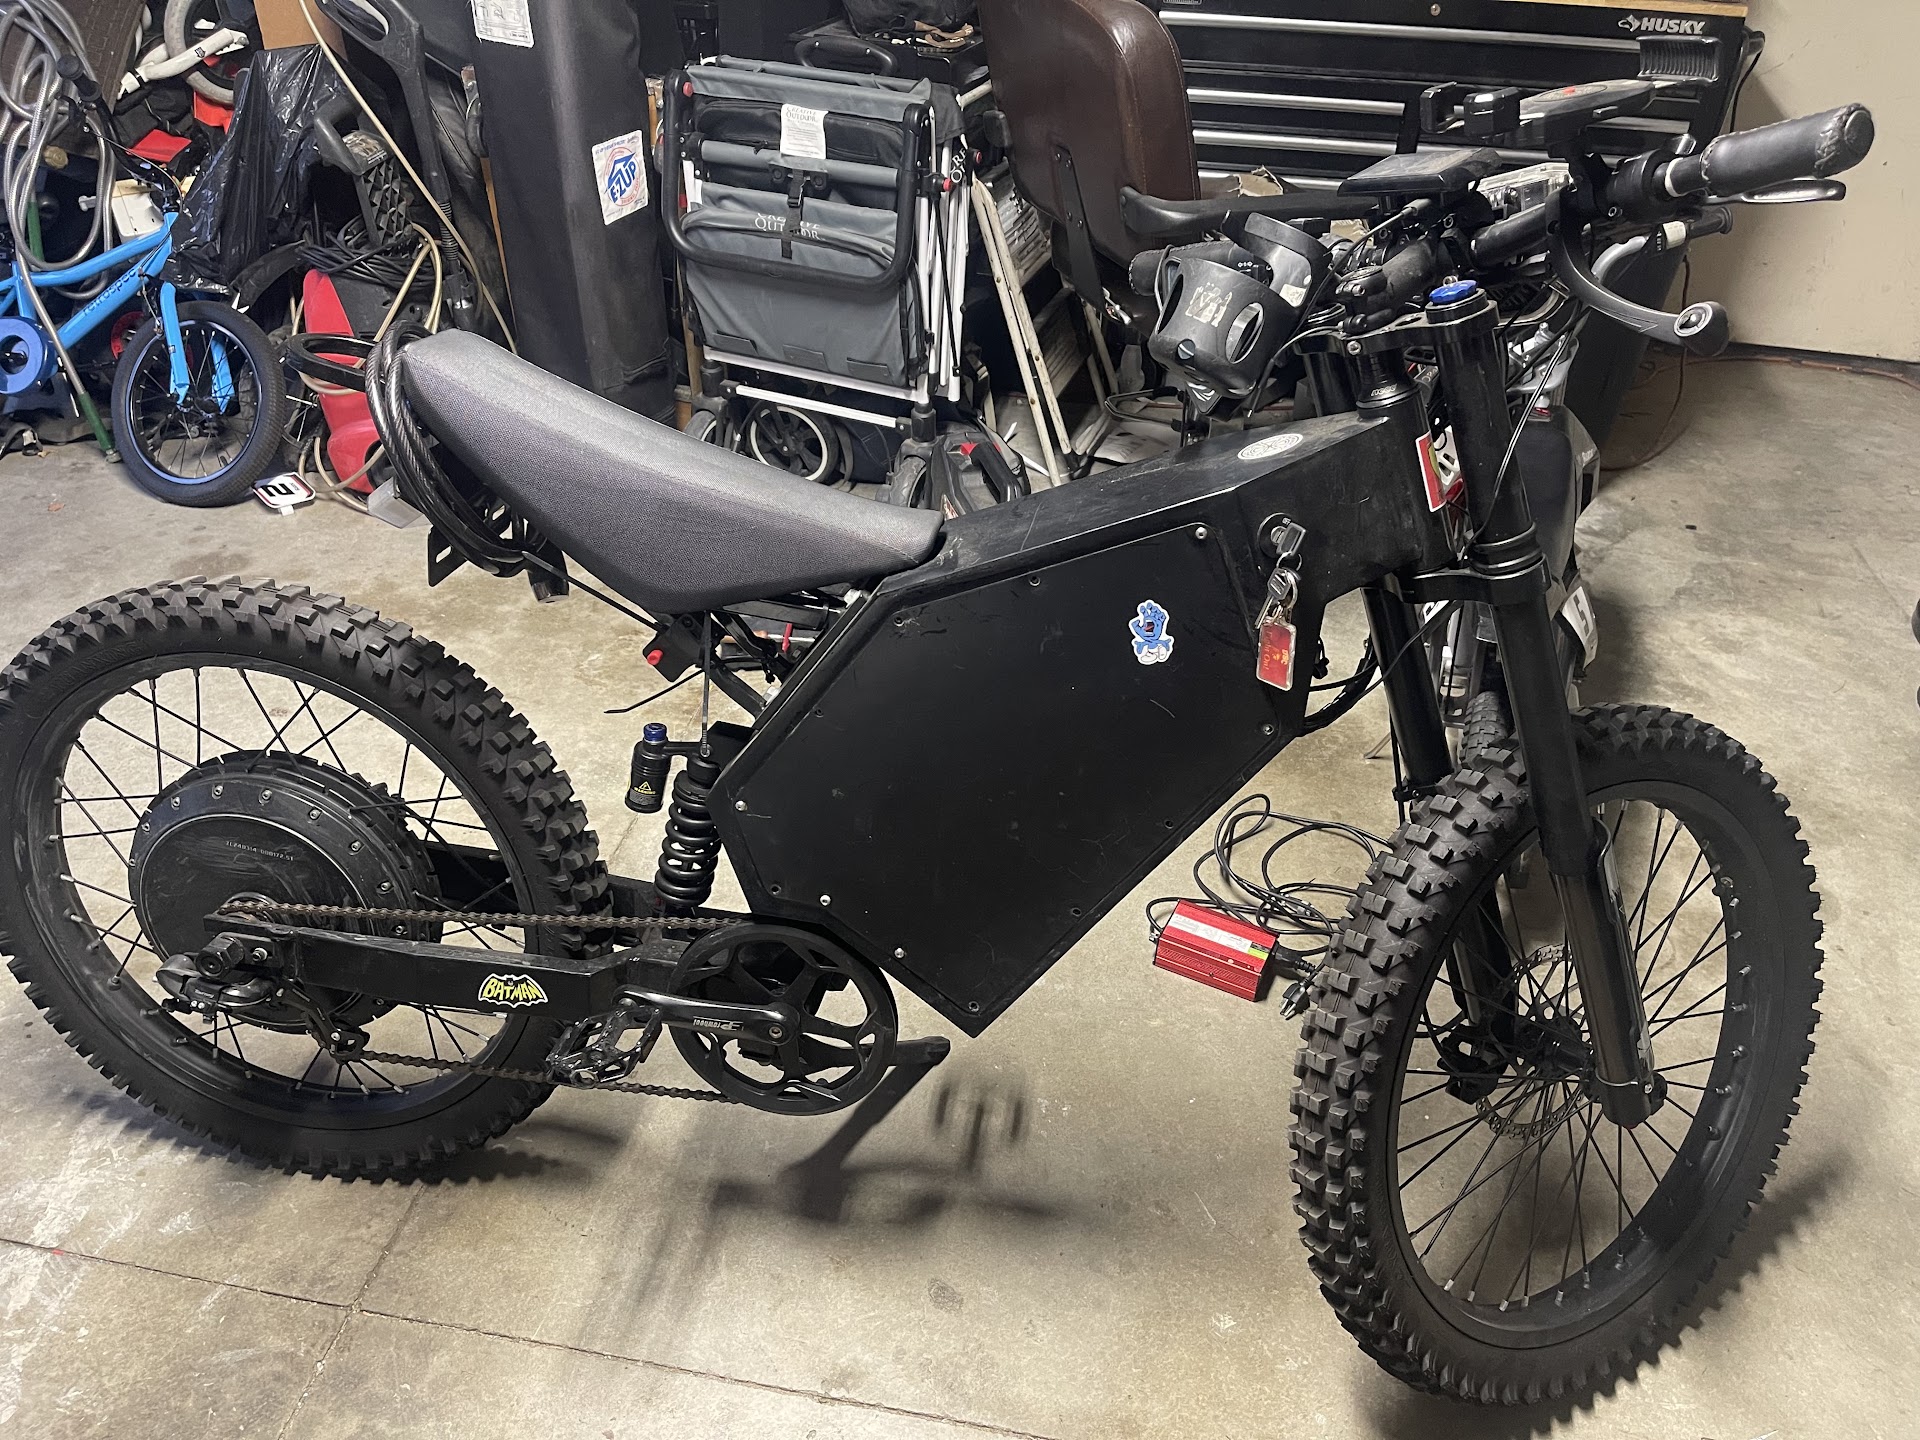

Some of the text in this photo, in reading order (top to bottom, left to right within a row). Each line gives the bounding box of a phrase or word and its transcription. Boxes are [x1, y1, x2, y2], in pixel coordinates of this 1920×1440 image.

[1640, 17, 1706, 34] HUSKY
[83, 268, 136, 316] retrospec
[482, 978, 544, 1001] BATMAN
